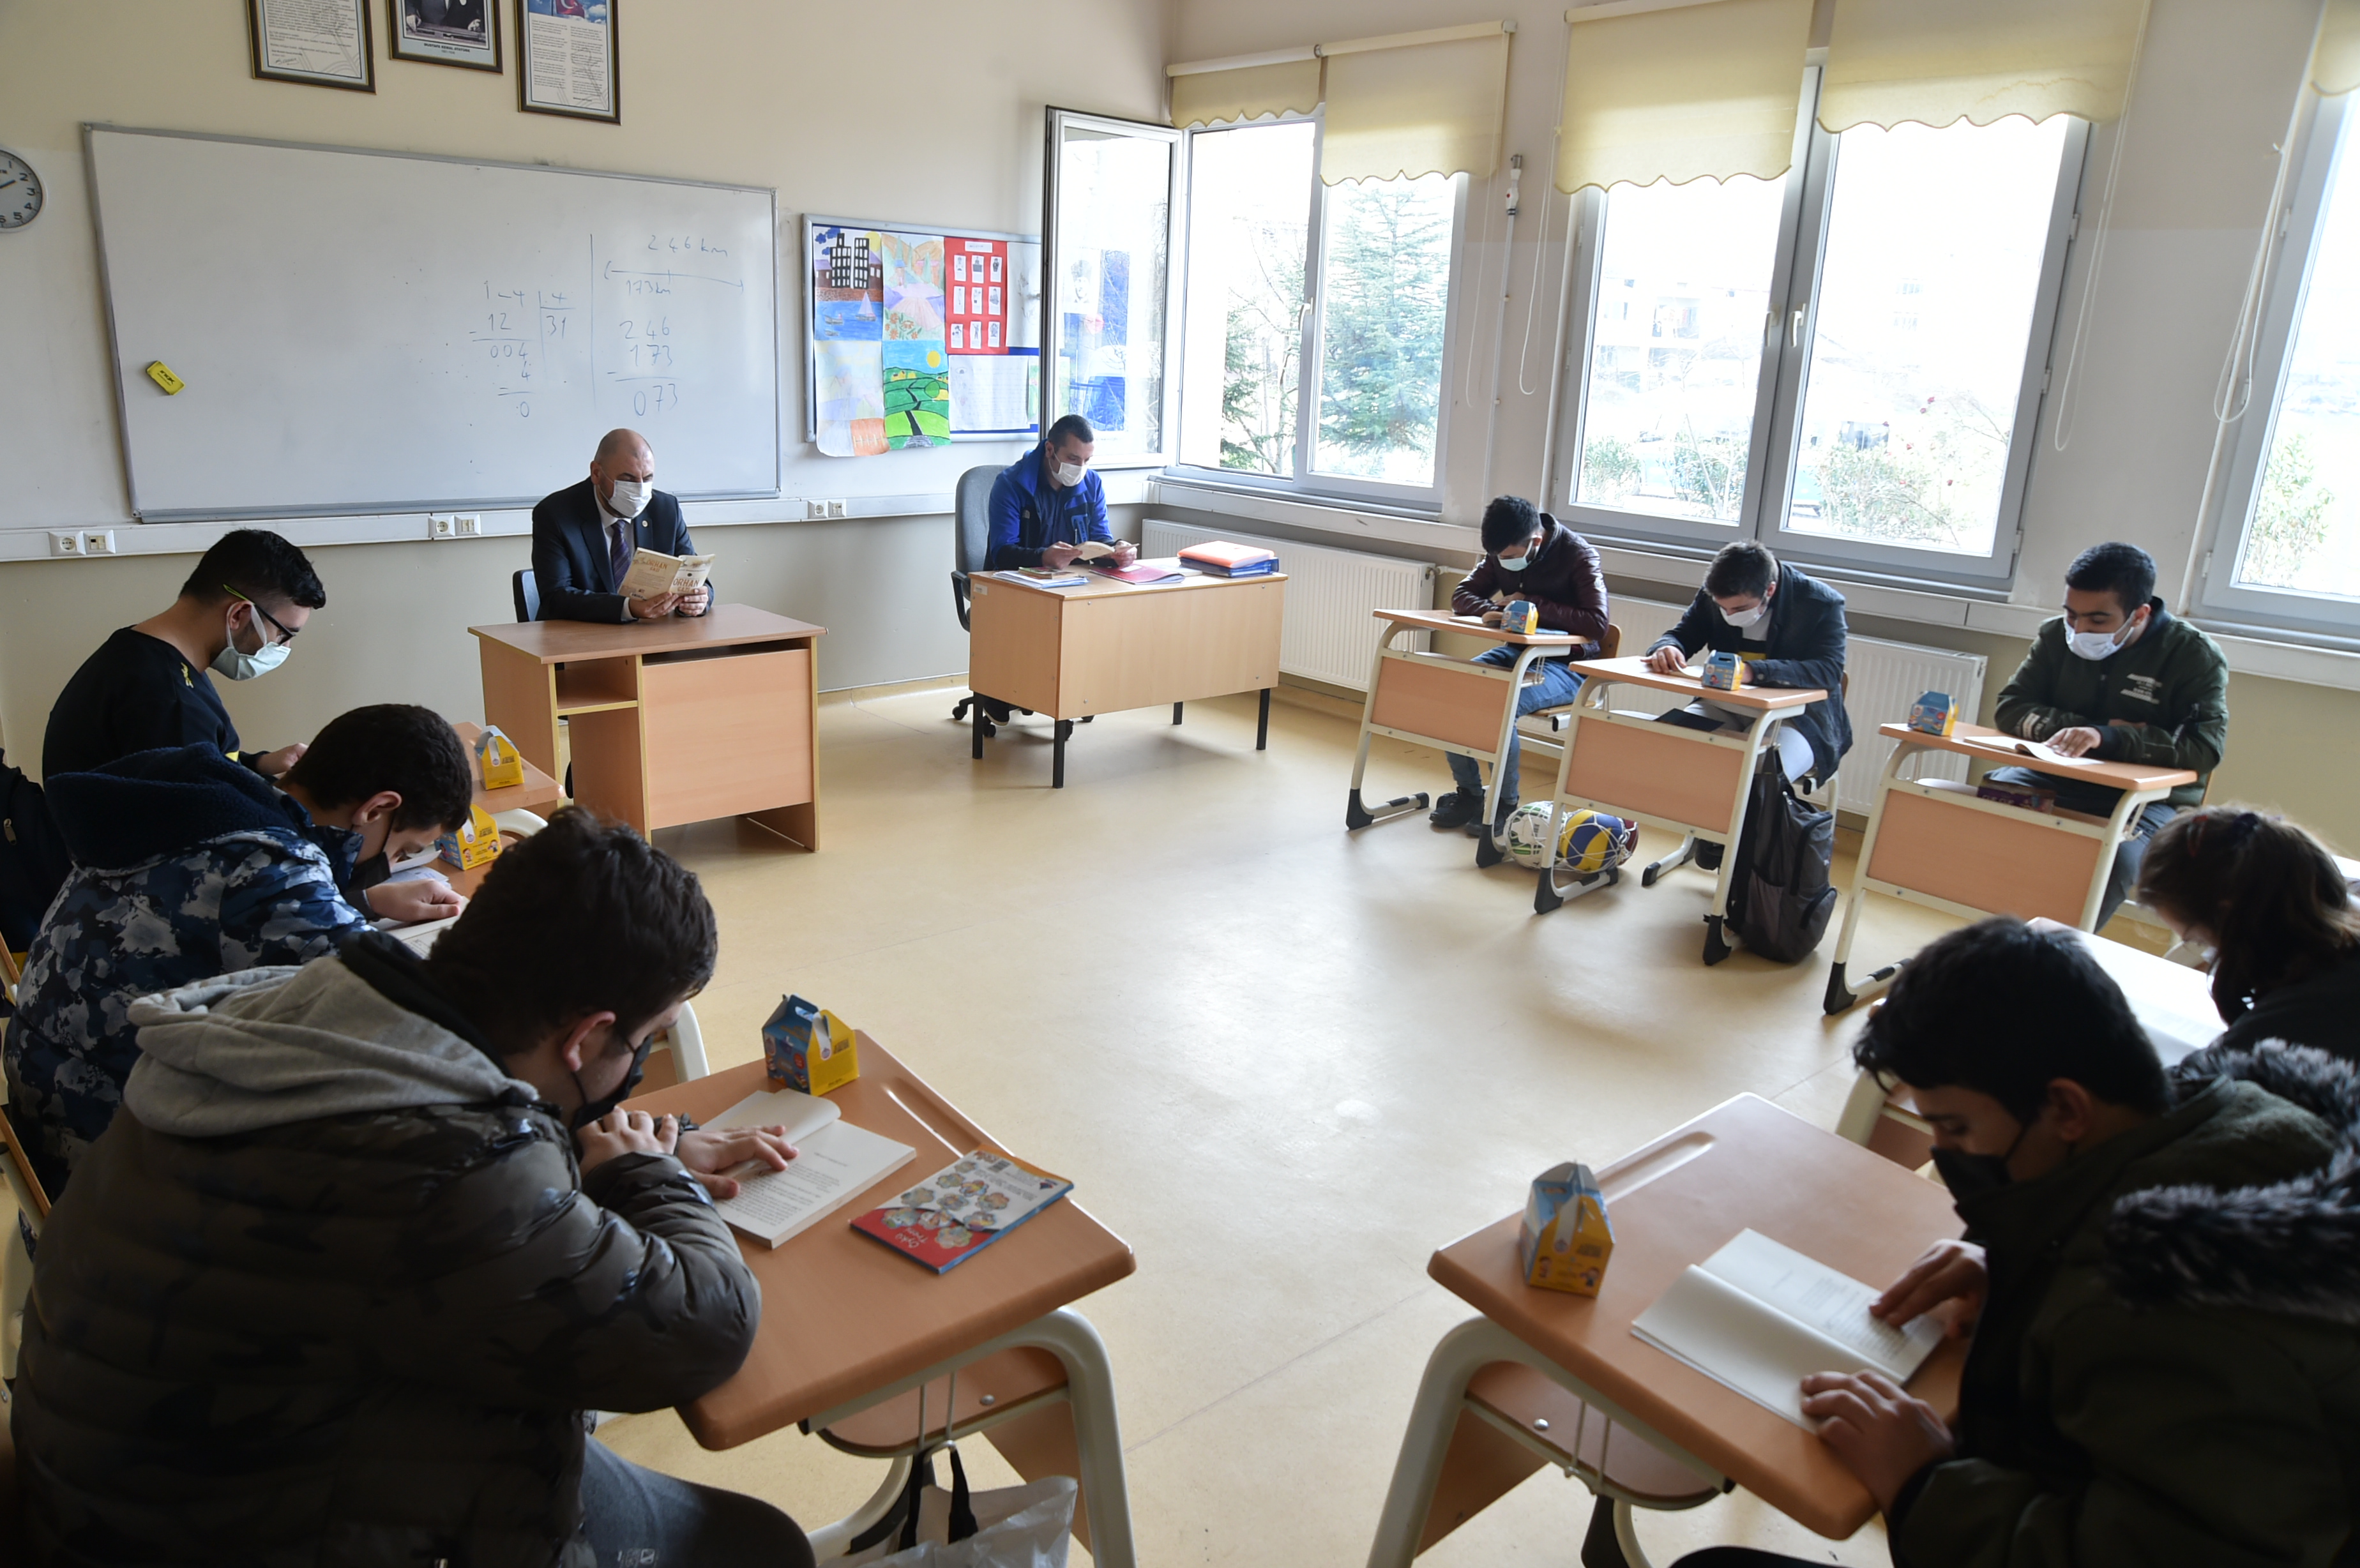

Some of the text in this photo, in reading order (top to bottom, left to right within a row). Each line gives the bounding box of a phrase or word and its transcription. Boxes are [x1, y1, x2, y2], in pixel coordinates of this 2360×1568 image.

[8, 160, 12, 169] 1
[19, 172, 29, 181] 2
[26, 187, 36, 196] 3
[24, 202, 33, 210] 4
[13, 211, 23, 220] 5
[647, 560, 667, 569] ORHAN
[673, 578, 699, 587] ORHAN
